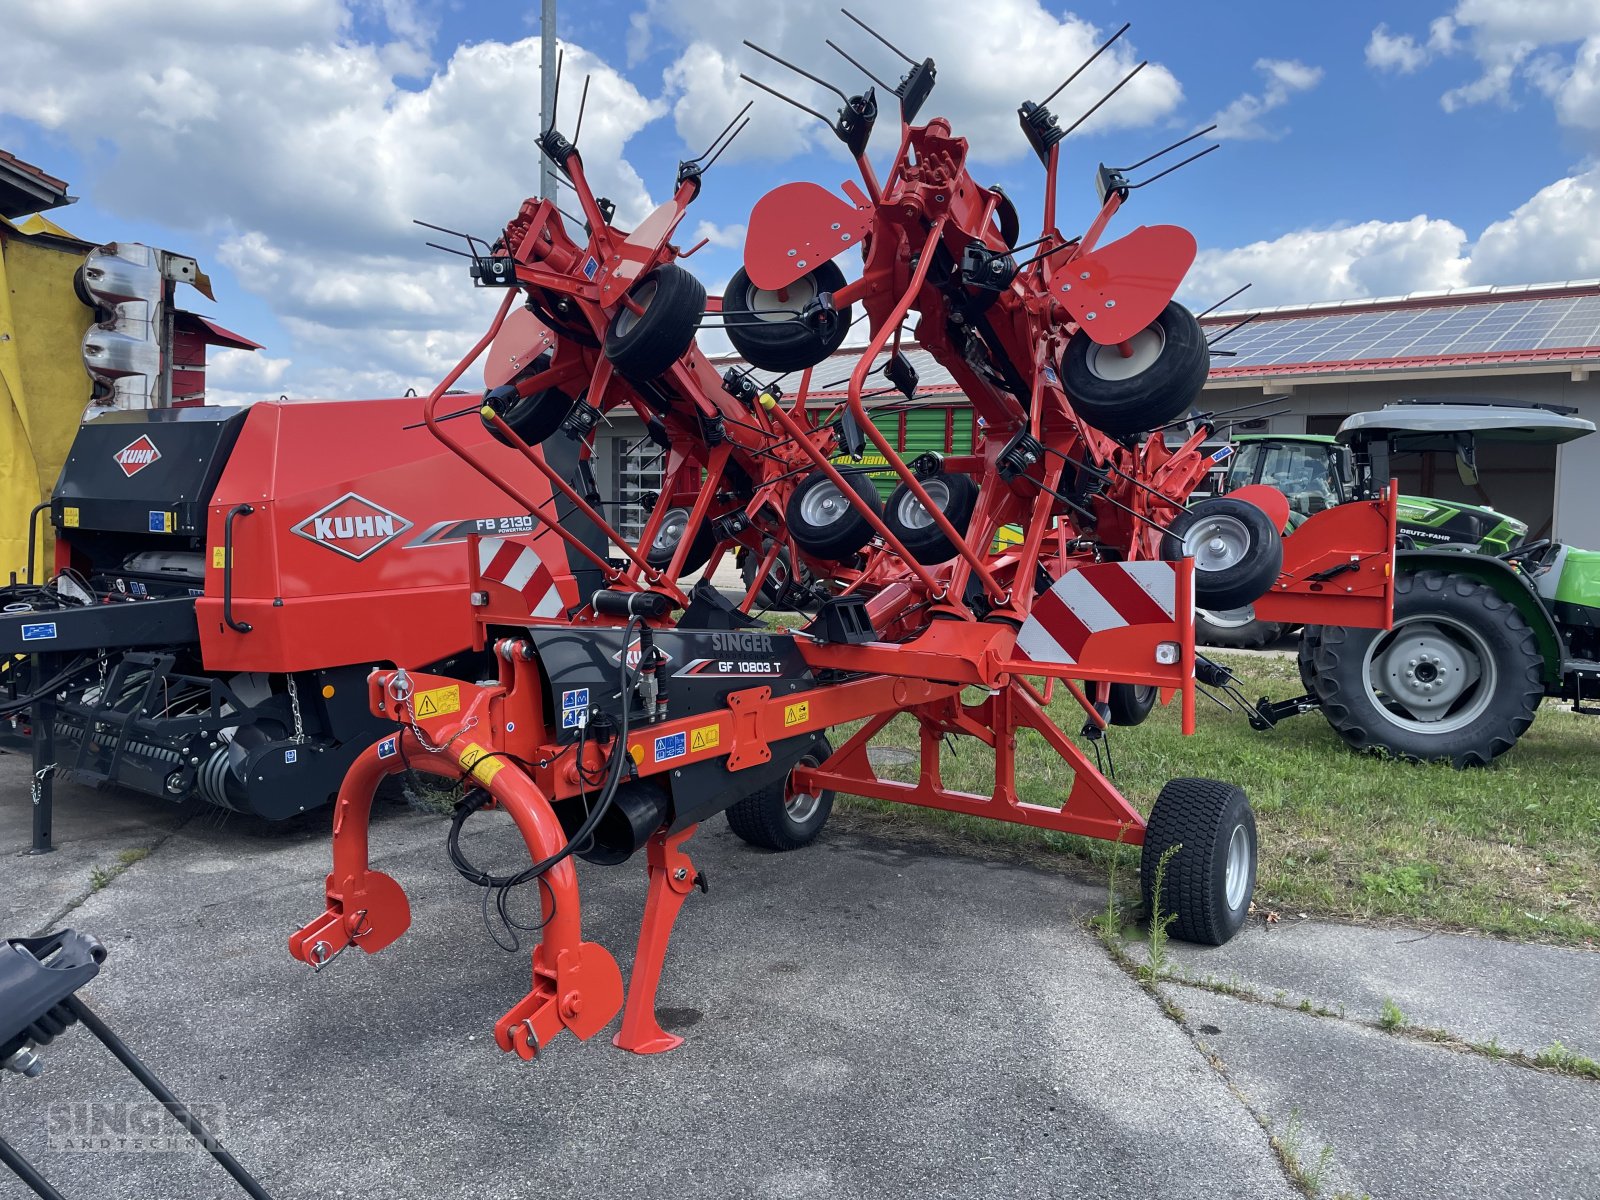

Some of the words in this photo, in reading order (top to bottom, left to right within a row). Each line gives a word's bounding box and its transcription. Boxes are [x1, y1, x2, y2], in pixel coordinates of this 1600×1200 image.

[120, 449, 155, 464] KUHN
[314, 515, 394, 540] KUHN
[475, 518, 496, 531] FB
[500, 516, 533, 529] 2130
[498, 526, 533, 534] POWERTRACK
[1399, 528, 1451, 541] DEUTZ-FAHR
[712, 632, 774, 653] SINGER
[718, 661, 735, 673] GF
[738, 661, 771, 673] 10803
[773, 662, 781, 673] T
